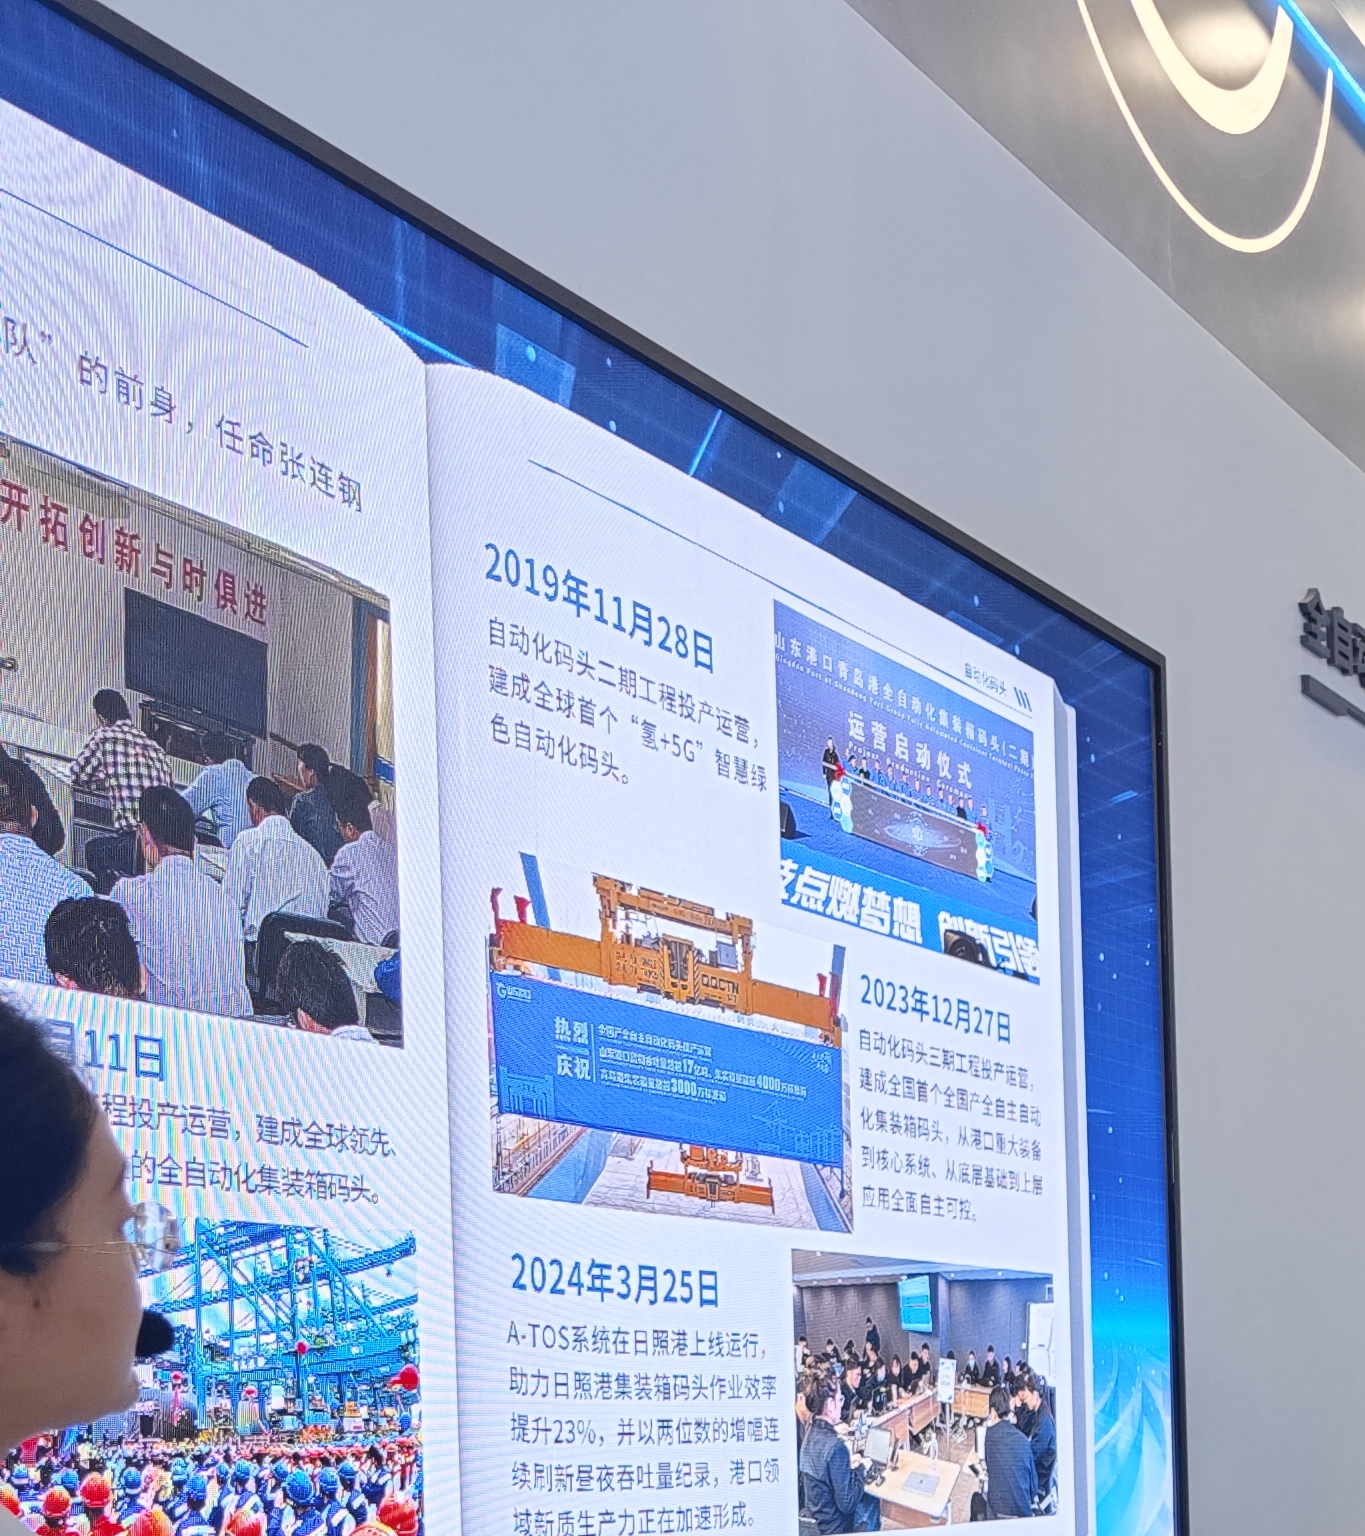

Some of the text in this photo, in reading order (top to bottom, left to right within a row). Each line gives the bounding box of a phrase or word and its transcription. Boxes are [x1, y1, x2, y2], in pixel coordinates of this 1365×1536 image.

[1, 478, 268, 627] 开拓创新与时俱进
[485, 543, 714, 674] 2019年11月28日
[848, 710, 972, 789] 运营启动仪式
[860, 974, 1011, 1044] 2023年12月27日
[556, 1055, 591, 1081] 庆祝
[862, 1184, 977, 1222] 应用全面自主可控。
[511, 1253, 719, 1308] 2024年3月25日
[509, 1366, 777, 1401] 助力日照港集装箱码头作业效率
